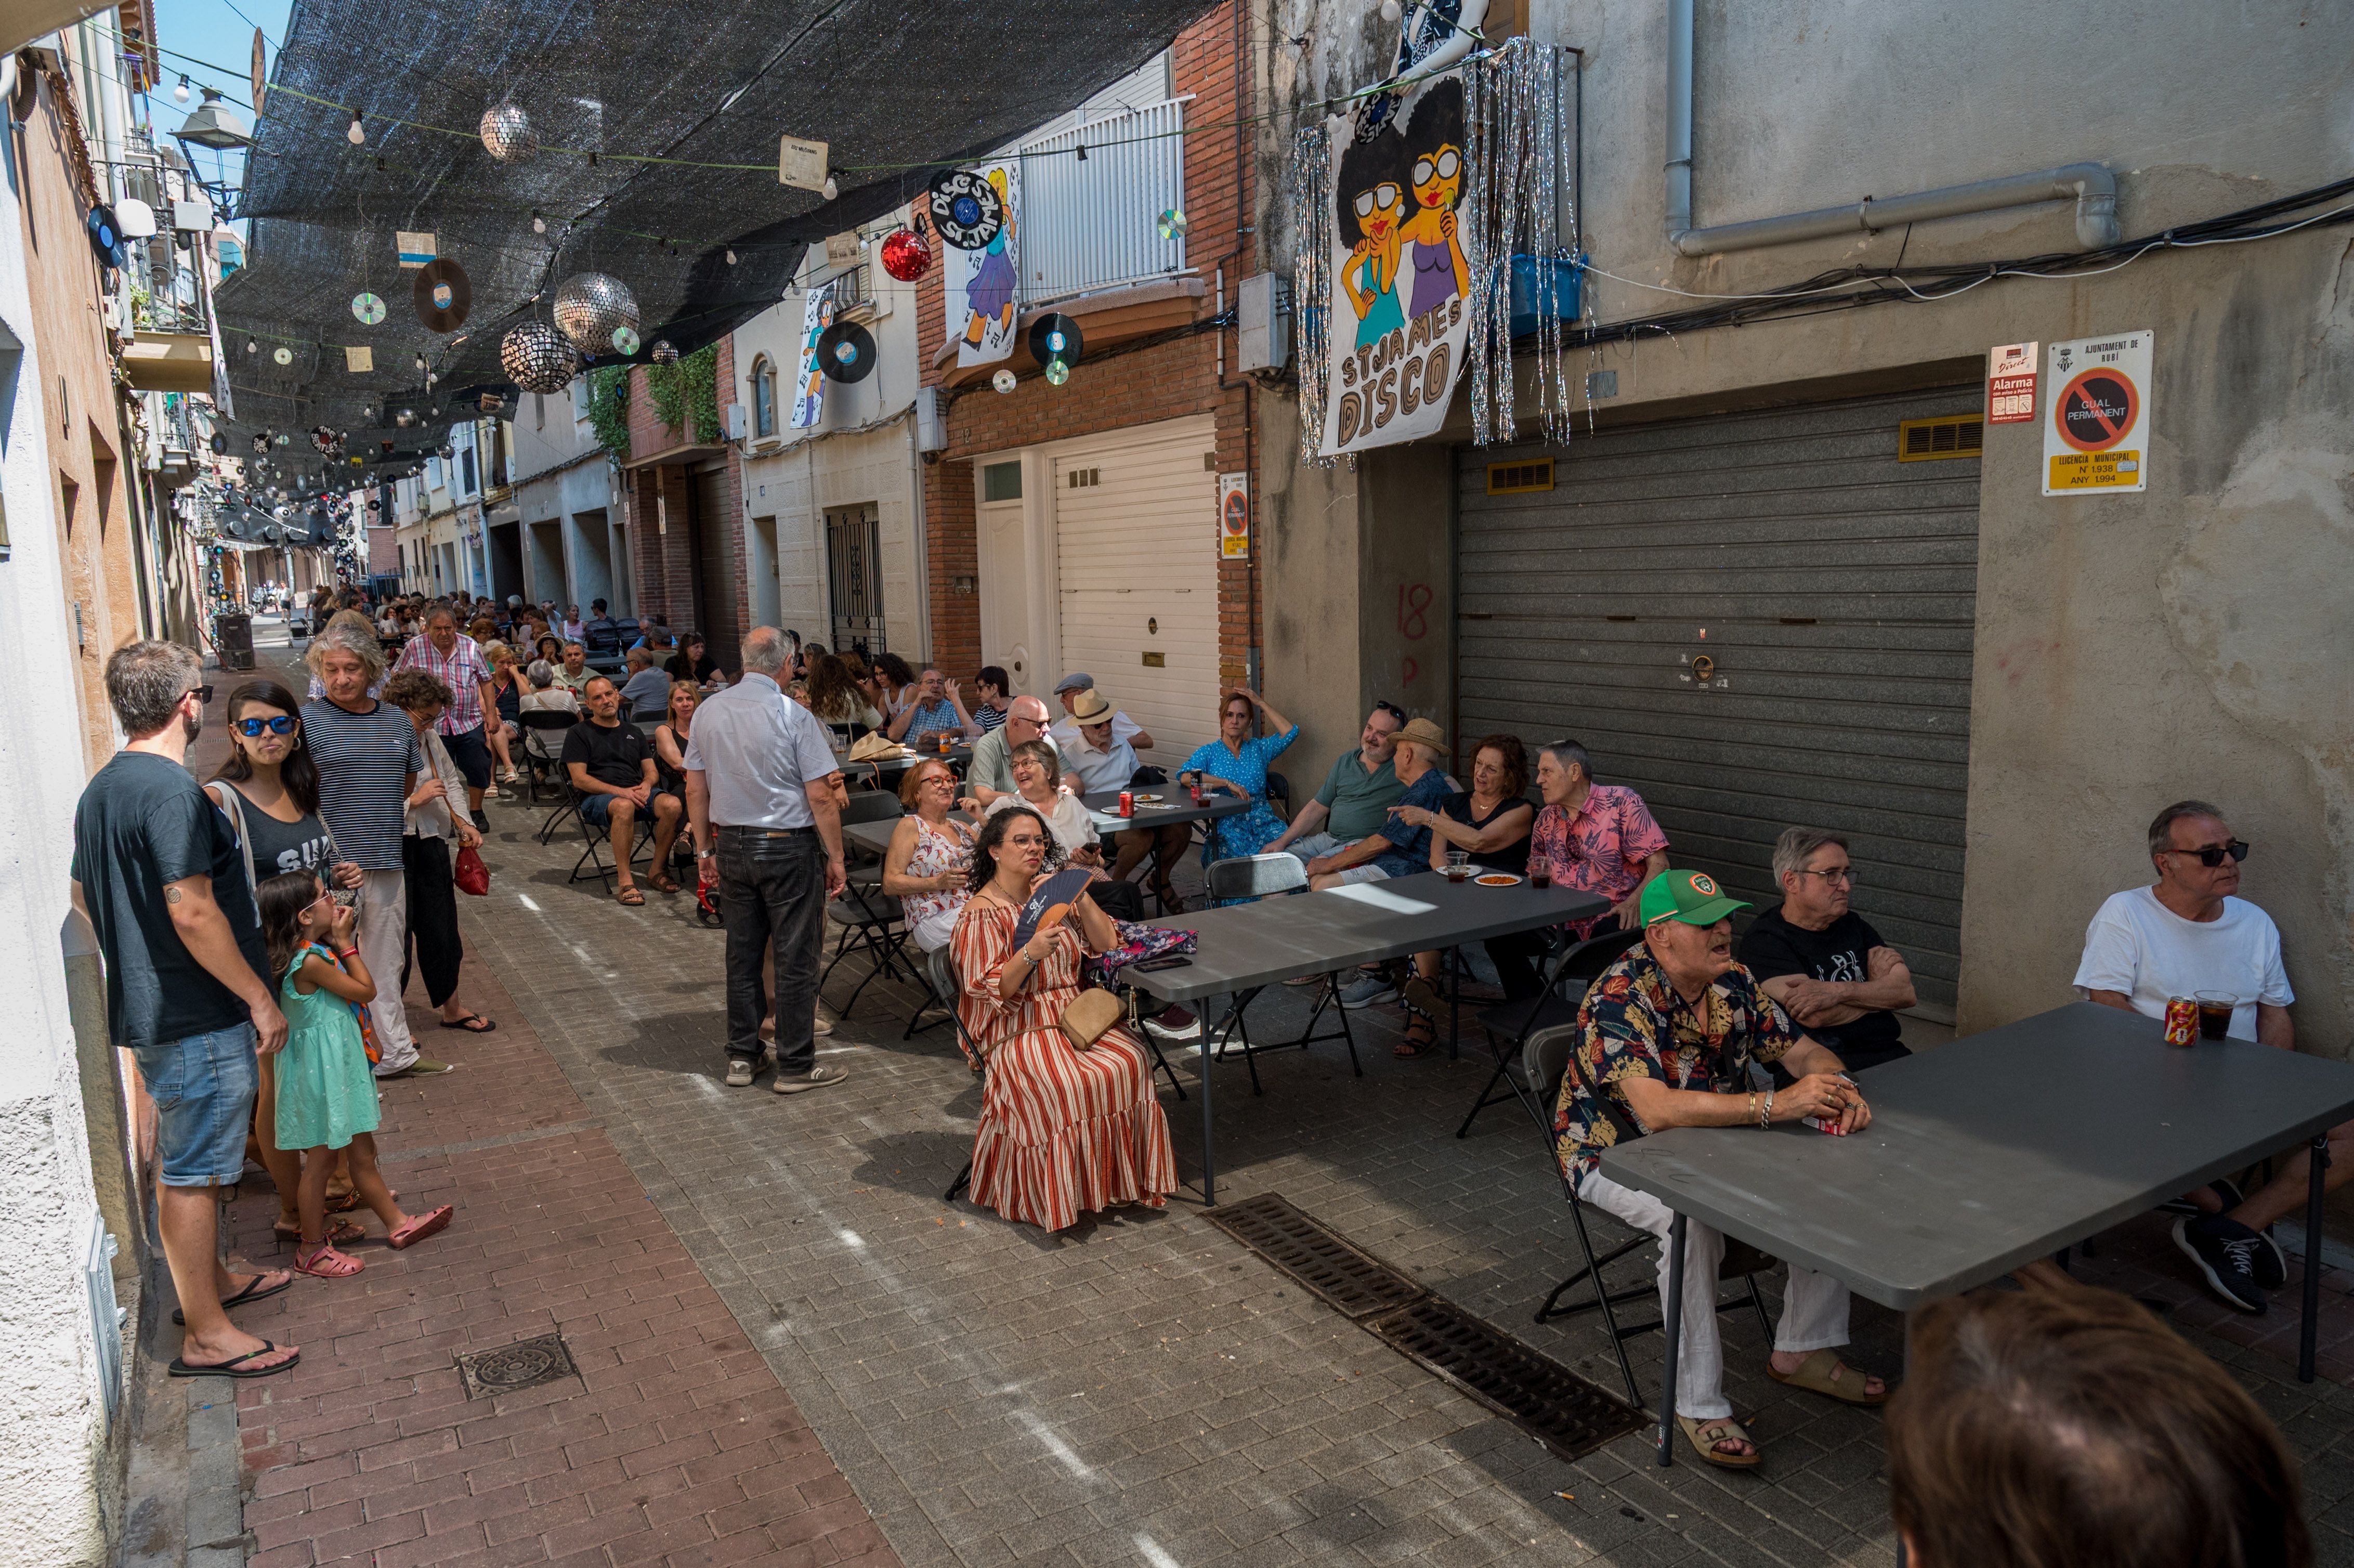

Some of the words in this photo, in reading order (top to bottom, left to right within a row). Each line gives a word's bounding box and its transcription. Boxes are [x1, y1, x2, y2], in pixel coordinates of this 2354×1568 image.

[799, 146, 817, 154] MUSTANG
[2085, 341, 2126, 354] AJUNTAMENT
[2130, 339, 2138, 348] DE
[2102, 351, 2118, 362] RUBÍ
[1993, 378, 2033, 390] Alarma
[1338, 343, 1450, 448] DISCO
[2082, 399, 2110, 409] GUAL
[2068, 407, 2126, 421] PERMANENT
[318, 425, 336, 439] THE
[960, 428, 970, 444] 12
[311, 433, 338, 453] BEATLES
[2059, 455, 2088, 465] LLICÈNCIA
[2095, 453, 2129, 462] MUNICIPAL
[2091, 465, 2113, 474] 1.938
[1397, 583, 1434, 640] 18
